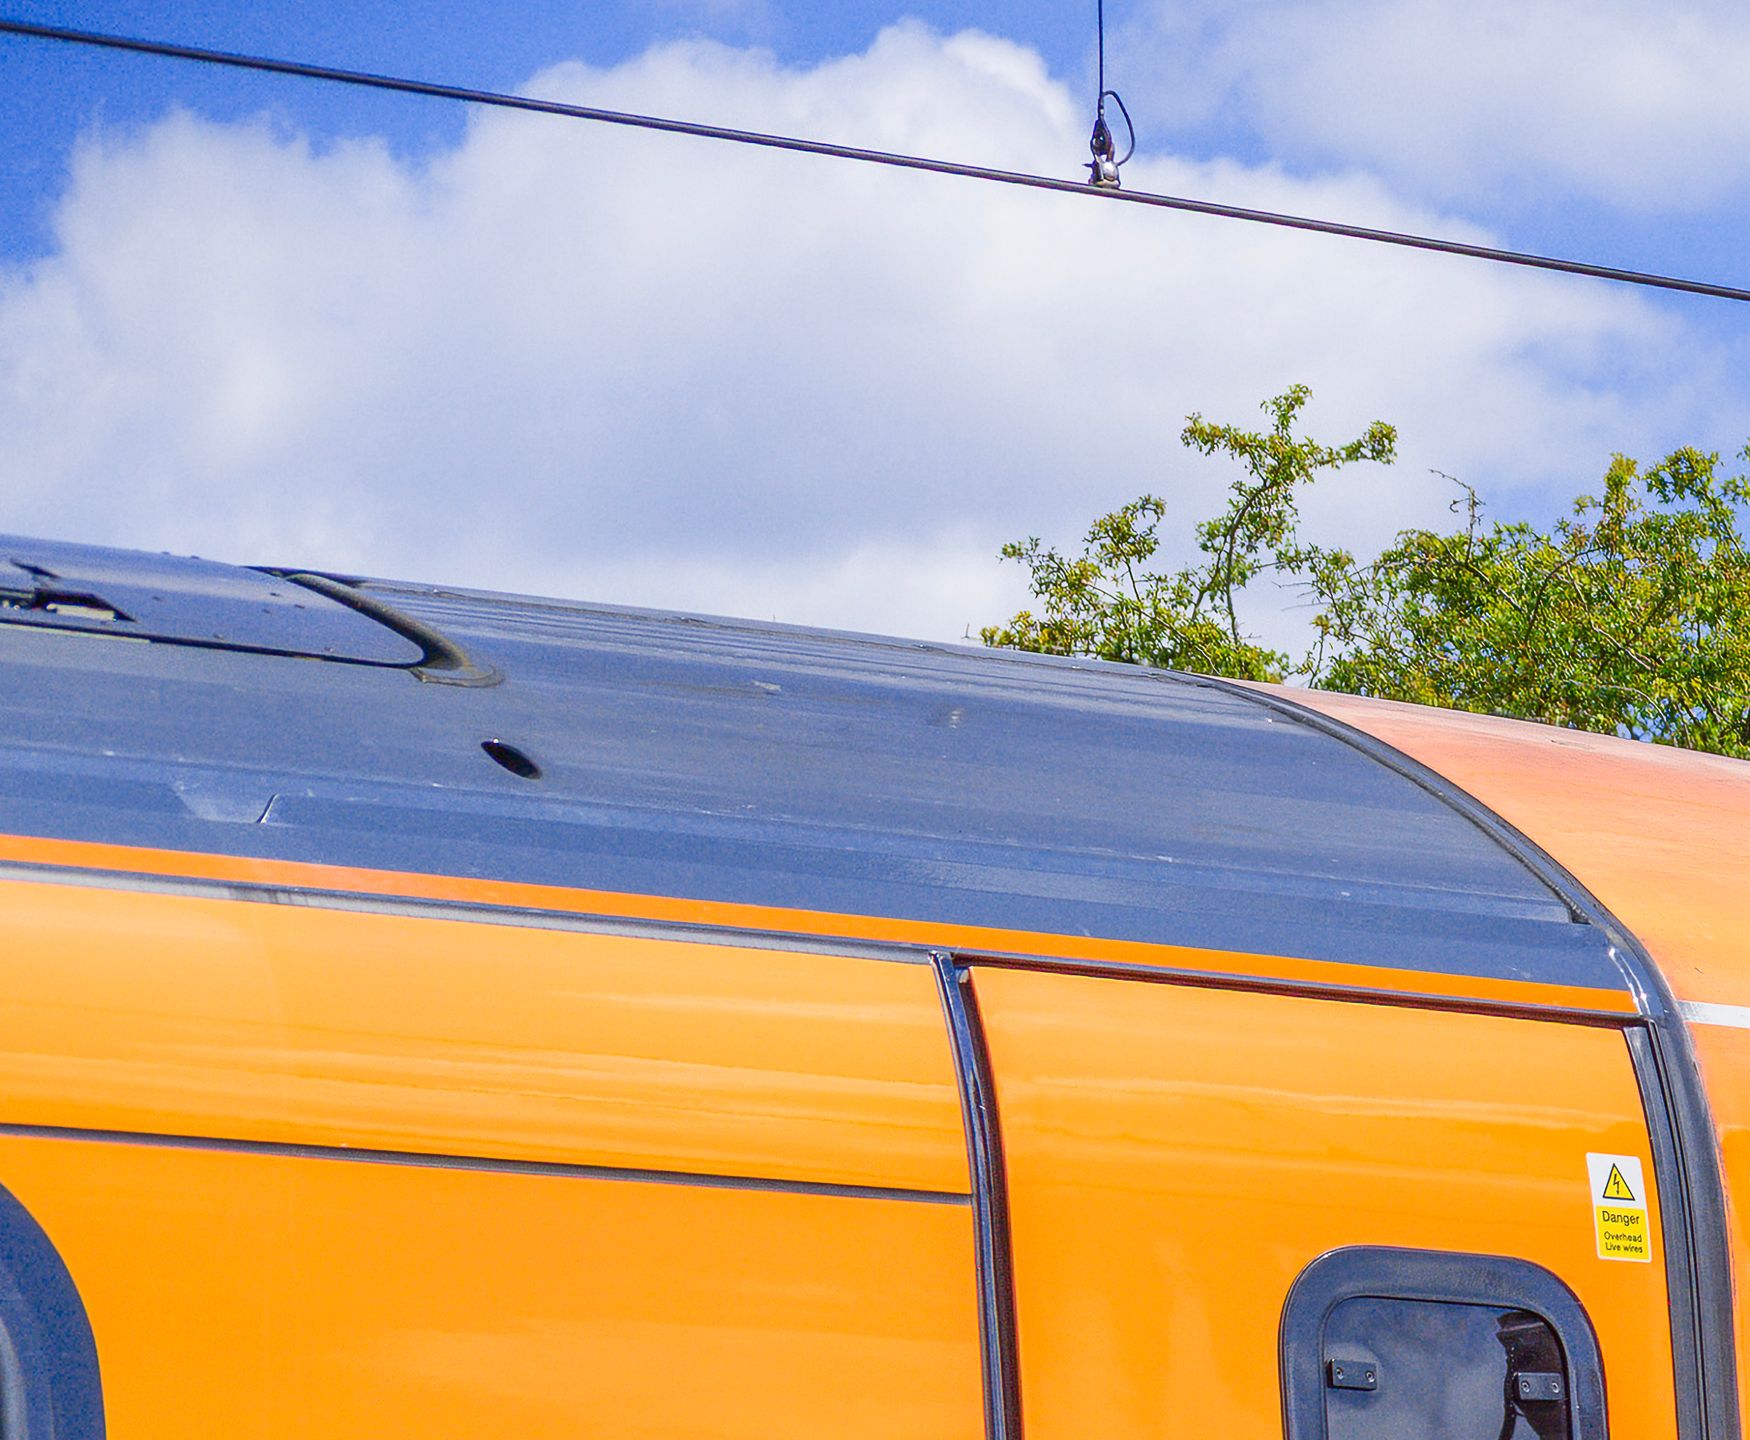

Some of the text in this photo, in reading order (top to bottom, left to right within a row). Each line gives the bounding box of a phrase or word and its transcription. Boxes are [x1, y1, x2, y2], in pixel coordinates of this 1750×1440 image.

[1602, 1210, 1640, 1227] Danger
[1604, 1230, 1643, 1243] Overhead
[1605, 1241, 1644, 1254] Live wires
